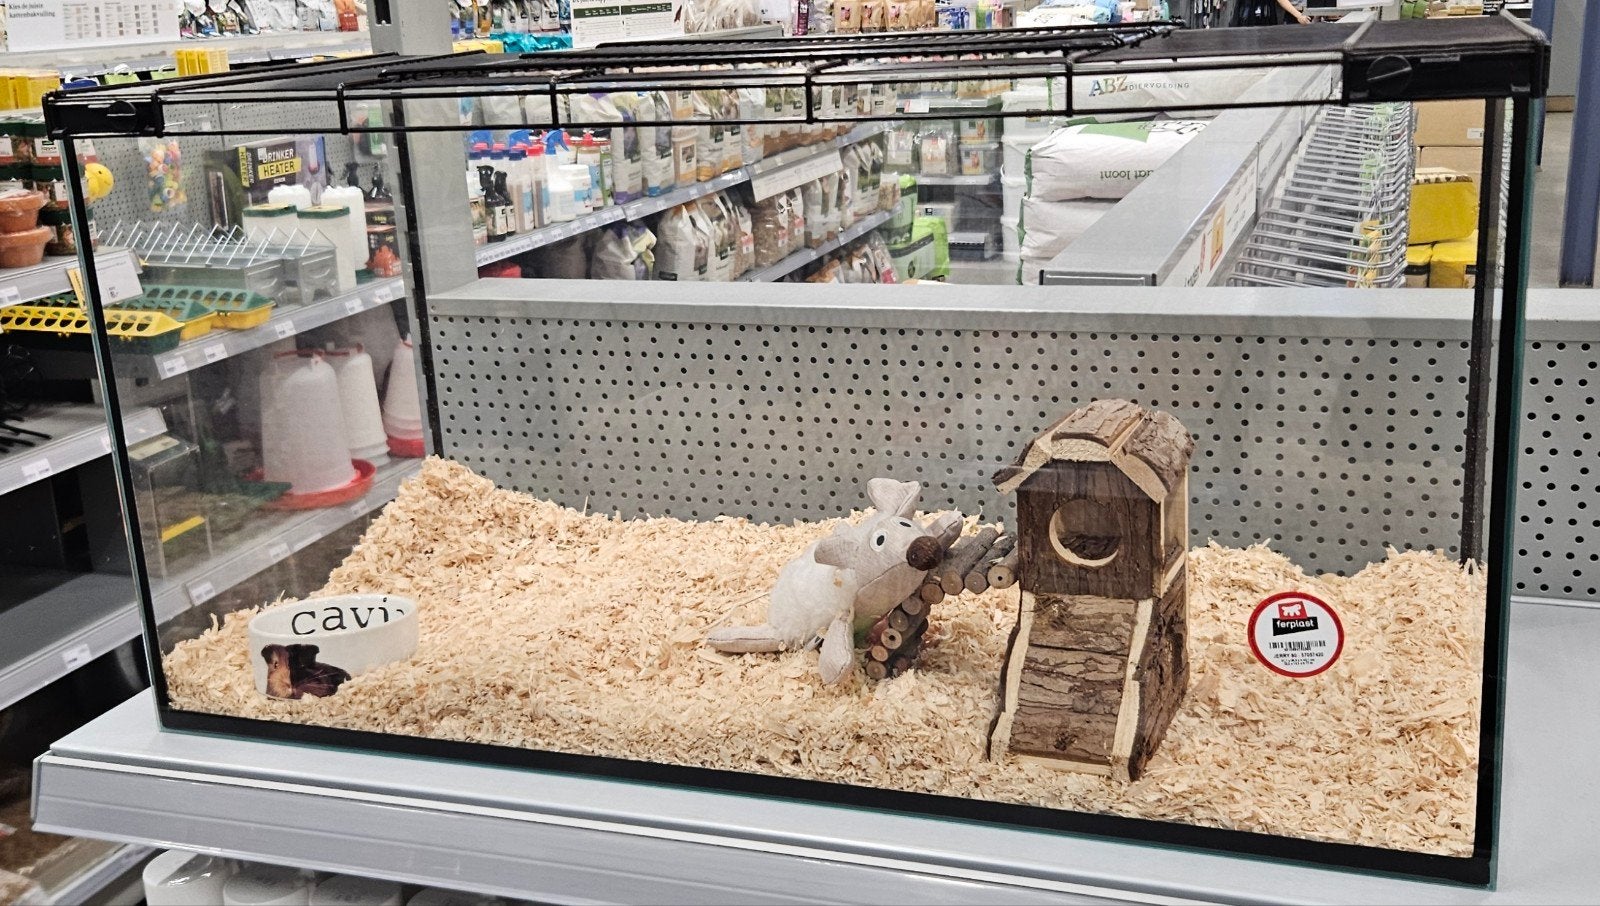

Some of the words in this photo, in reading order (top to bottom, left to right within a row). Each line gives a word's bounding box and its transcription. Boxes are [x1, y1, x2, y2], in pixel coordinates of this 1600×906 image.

[1088, 75, 1128, 97] ABZ
[264, 161, 296, 177] HEATER
[291, 597, 405, 636] cavi
[1276, 619, 1315, 629] ferplast
